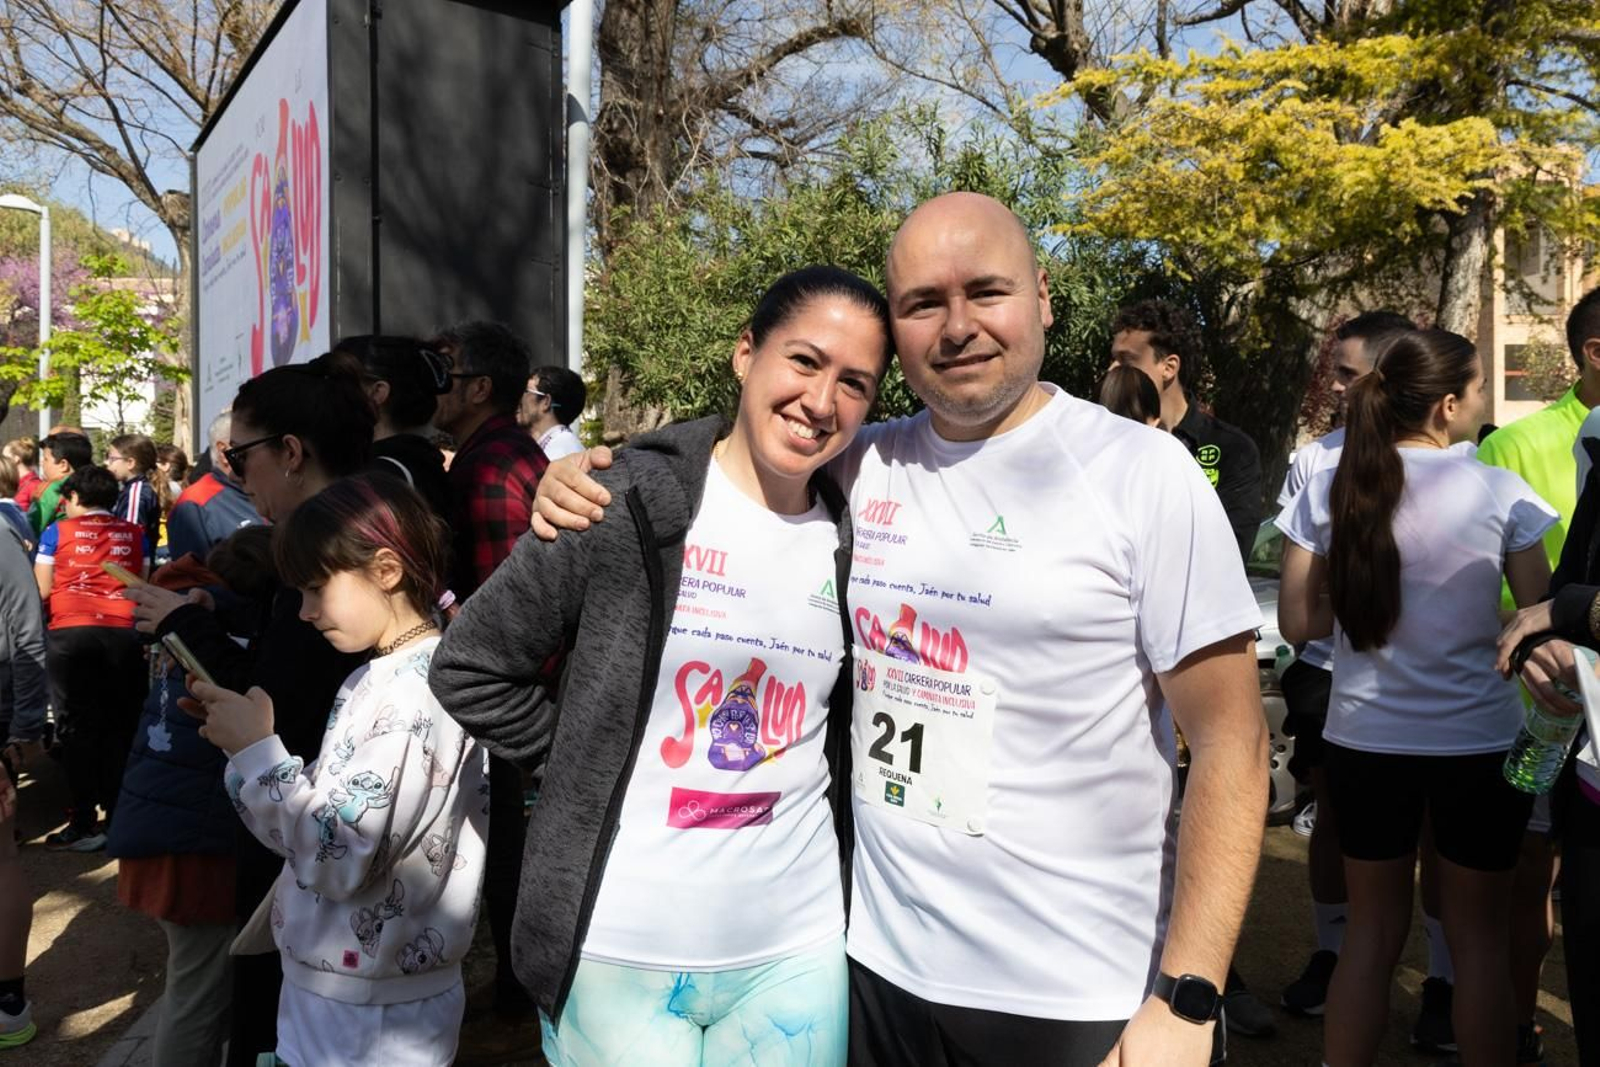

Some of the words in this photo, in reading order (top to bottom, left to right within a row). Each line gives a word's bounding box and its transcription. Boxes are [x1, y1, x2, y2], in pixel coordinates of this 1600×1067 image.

[680, 575, 700, 590] ERA
[701, 579, 747, 599] POPULAR
[889, 582, 917, 595] cuenta,
[919, 583, 939, 596] Jaén
[941, 590, 954, 600] por
[956, 591, 966, 602] tu
[968, 593, 992, 607] salud
[691, 626, 712, 639] cada
[715, 632, 734, 642] paso
[736, 636, 767, 649] cuenta,
[768, 637, 790, 652] Jaén
[792, 645, 806, 656] por
[807, 649, 816, 657] tu
[904, 672, 933, 689] CARRERA
[933, 679, 972, 697] POPULAR
[943, 696, 976, 710] INCLUSIVA
[868, 711, 925, 775] 21
[878, 766, 913, 786] REQUENA
[709, 805, 770, 815] MACROSA
